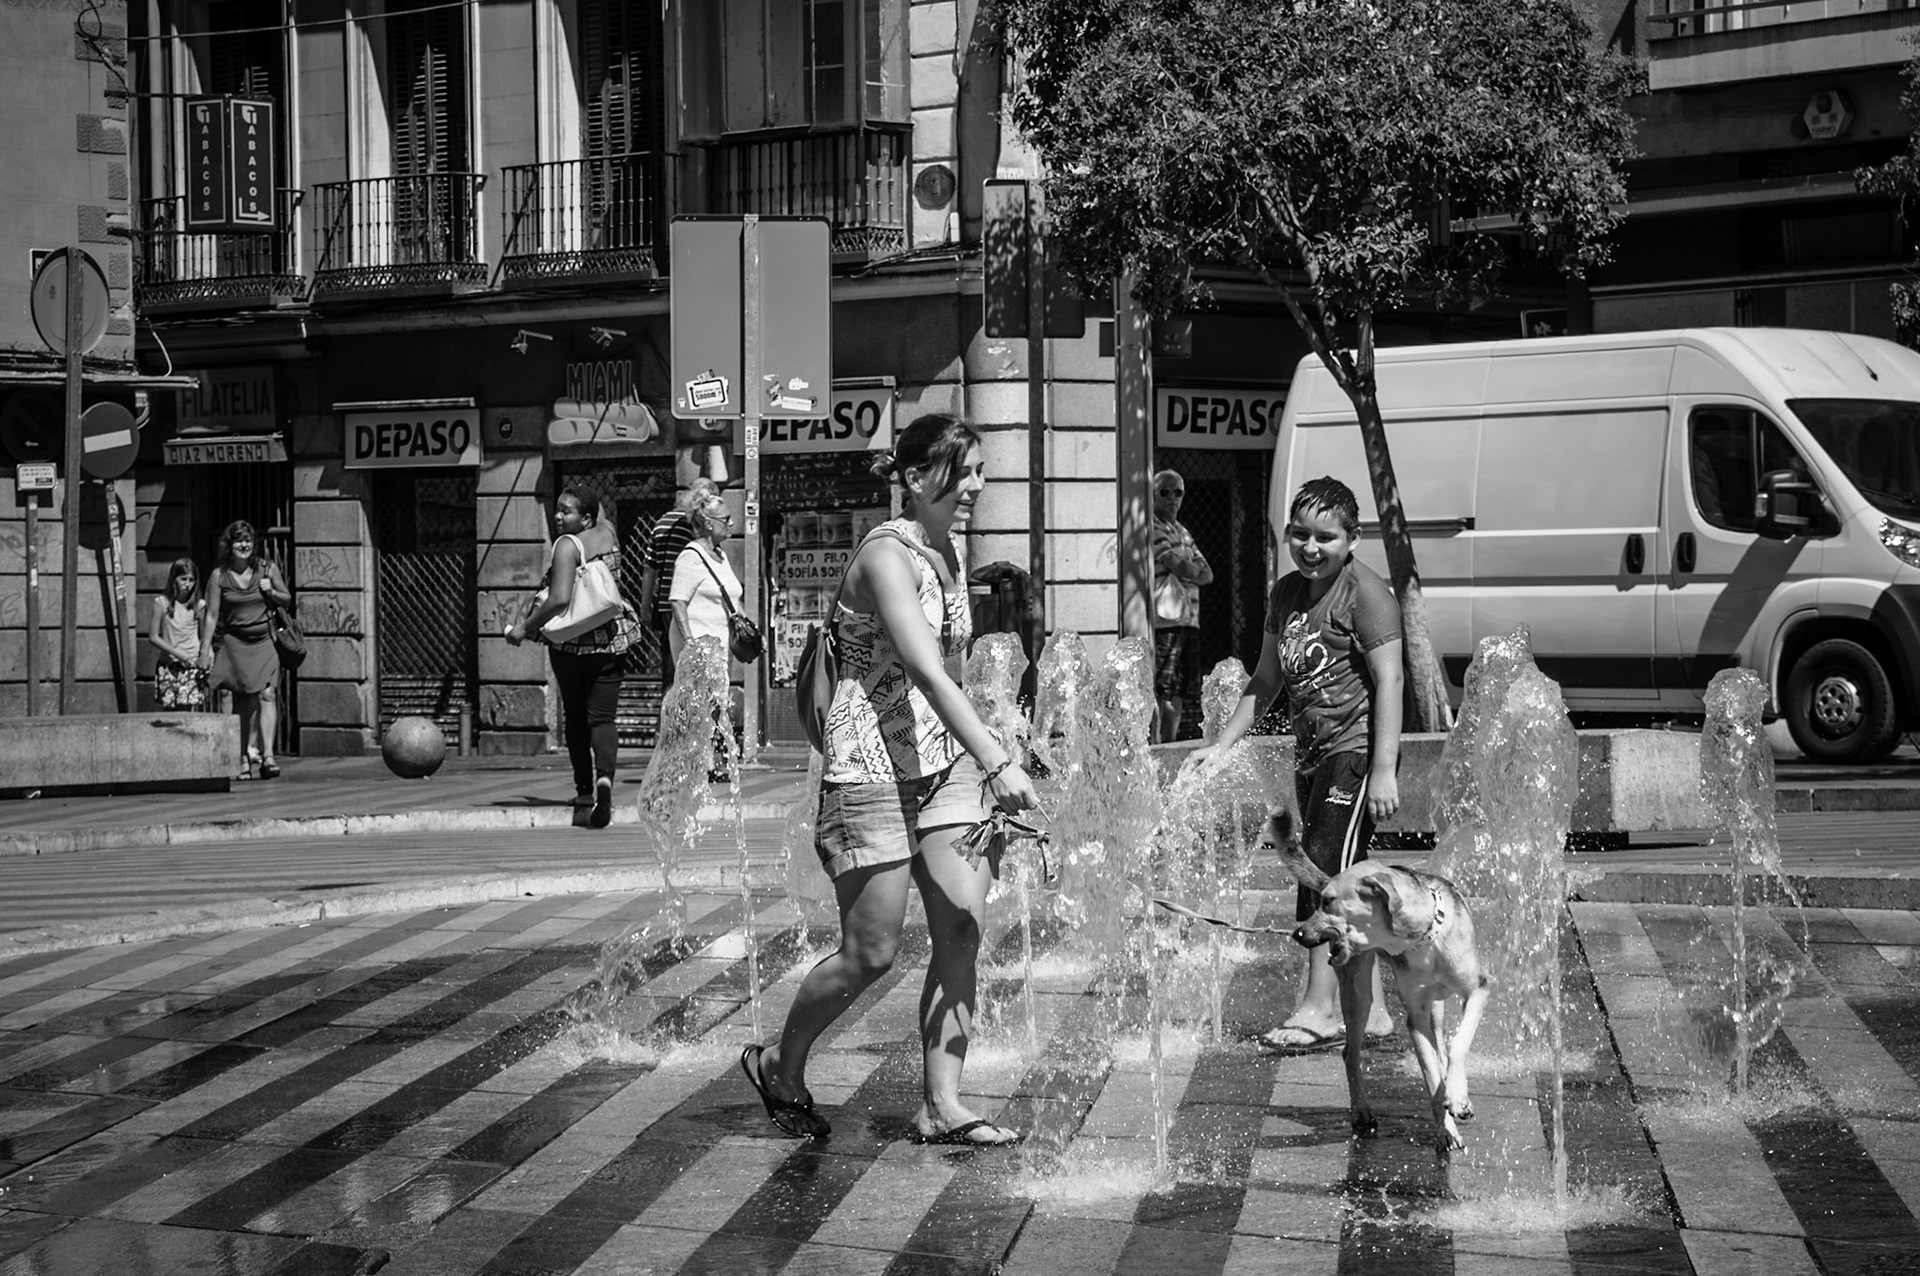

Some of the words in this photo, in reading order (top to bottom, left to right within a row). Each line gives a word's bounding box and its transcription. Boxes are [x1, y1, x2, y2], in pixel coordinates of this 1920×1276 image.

[241, 105, 258, 212] TABACOS
[182, 380, 271, 417] FILATELIA
[566, 360, 632, 406] MIAMI
[355, 419, 470, 459] DEPASO
[759, 400, 881, 441] EPASO
[206, 444, 263, 462] MORENO
[787, 564, 819, 578] SOFÍA
[820, 563, 844, 578] SOFÍ
[790, 553, 814, 564] FILO
[824, 552, 848, 563] FILO
[791, 624, 807, 634] FIL
